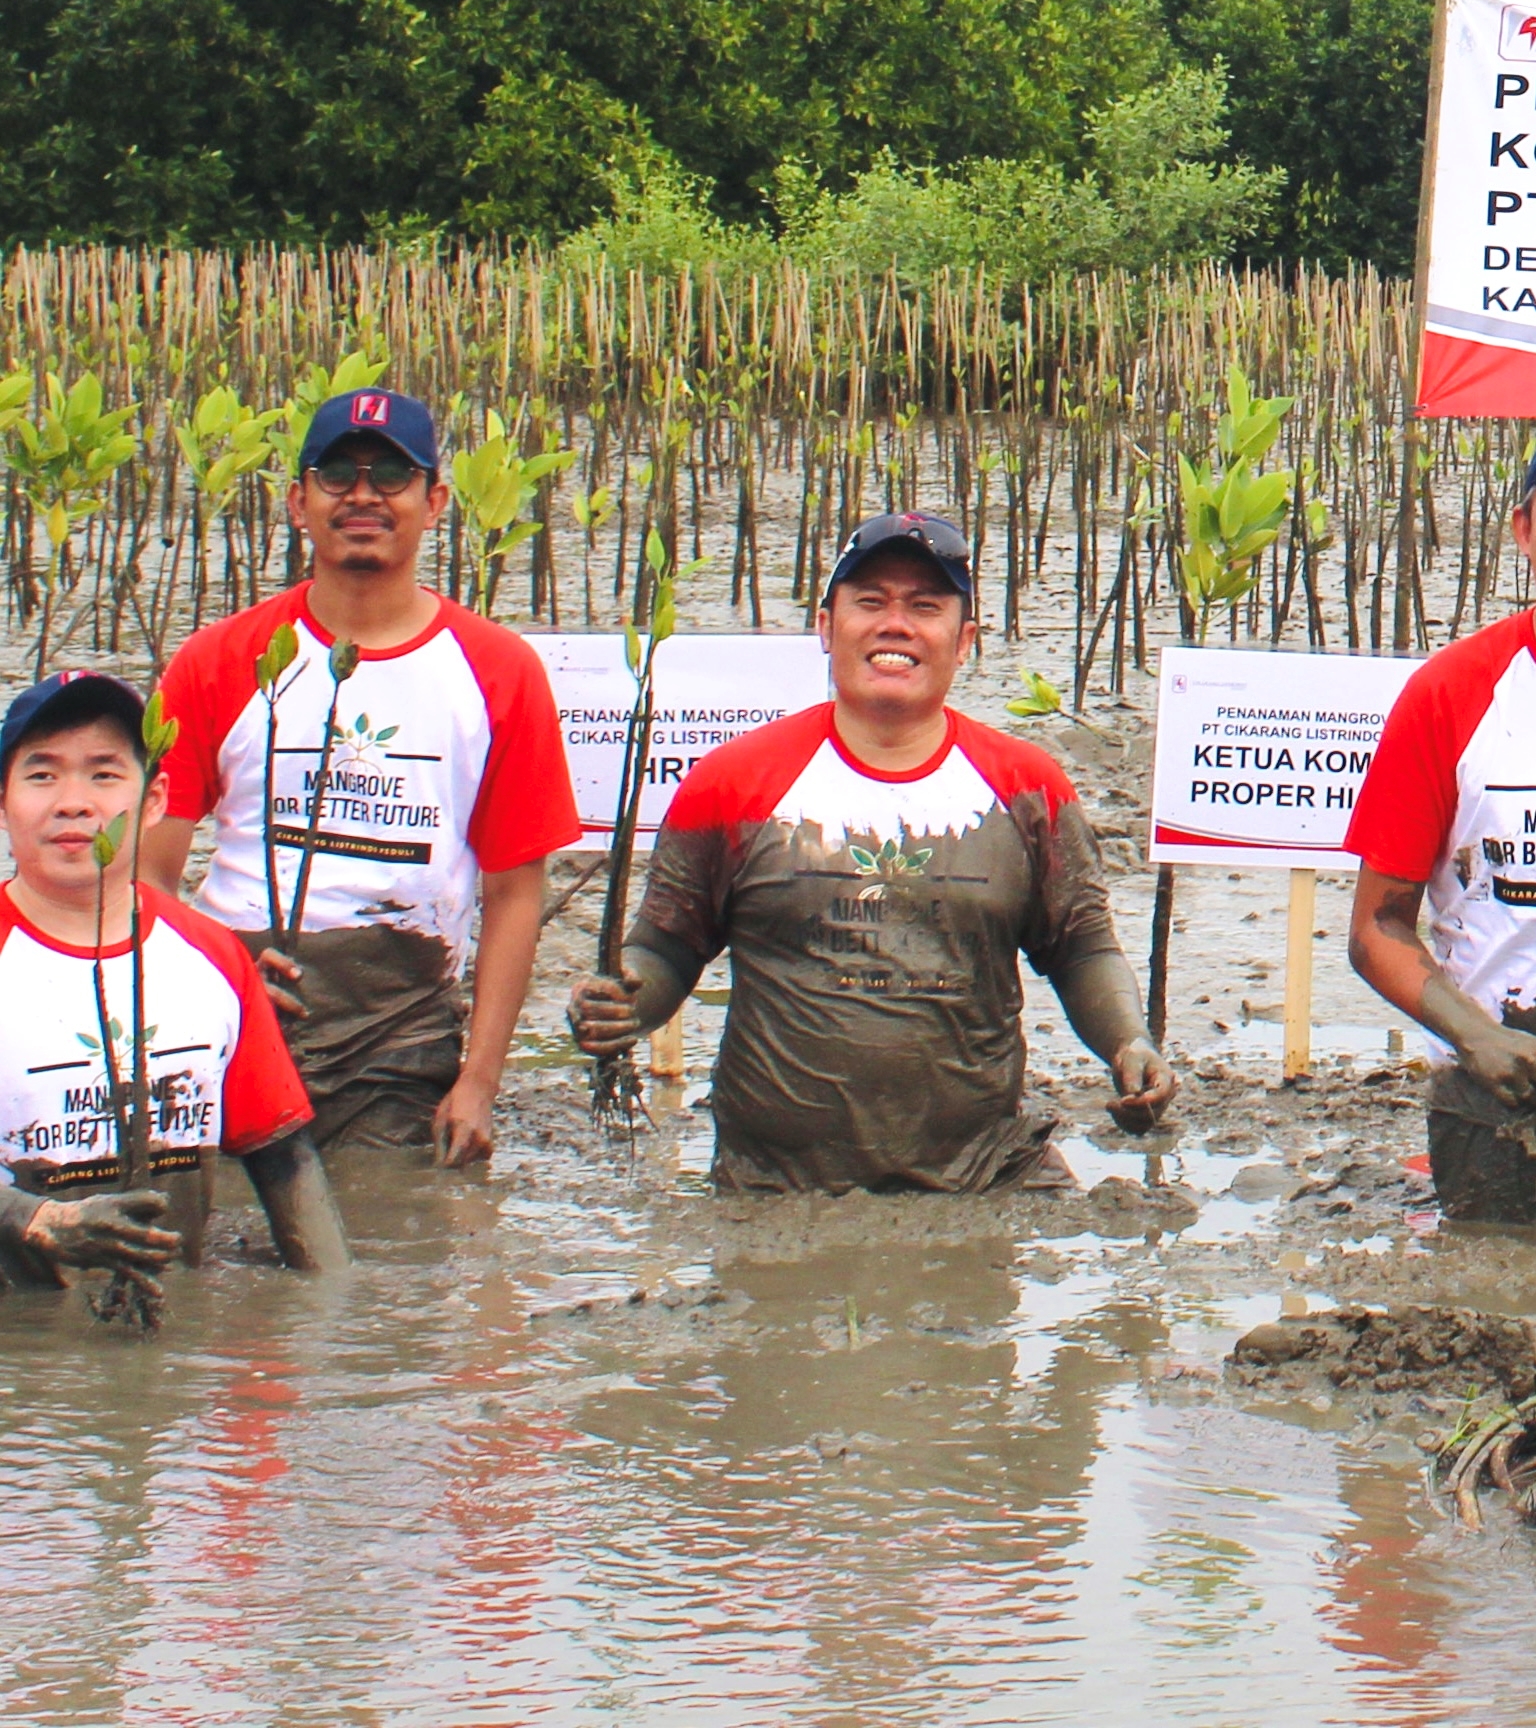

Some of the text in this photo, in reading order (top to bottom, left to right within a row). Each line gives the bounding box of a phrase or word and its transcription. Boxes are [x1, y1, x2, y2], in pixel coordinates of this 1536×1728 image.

[559, 709, 675, 722] PENANAAN
[1217, 707, 1310, 722] PENANAMAN
[1202, 724, 1220, 735] PT
[1224, 725, 1301, 738] CIKARANG
[1194, 745, 1295, 771] KETUA
[1191, 781, 1315, 807] PROPER
[375, 804, 440, 827] FUTURE
